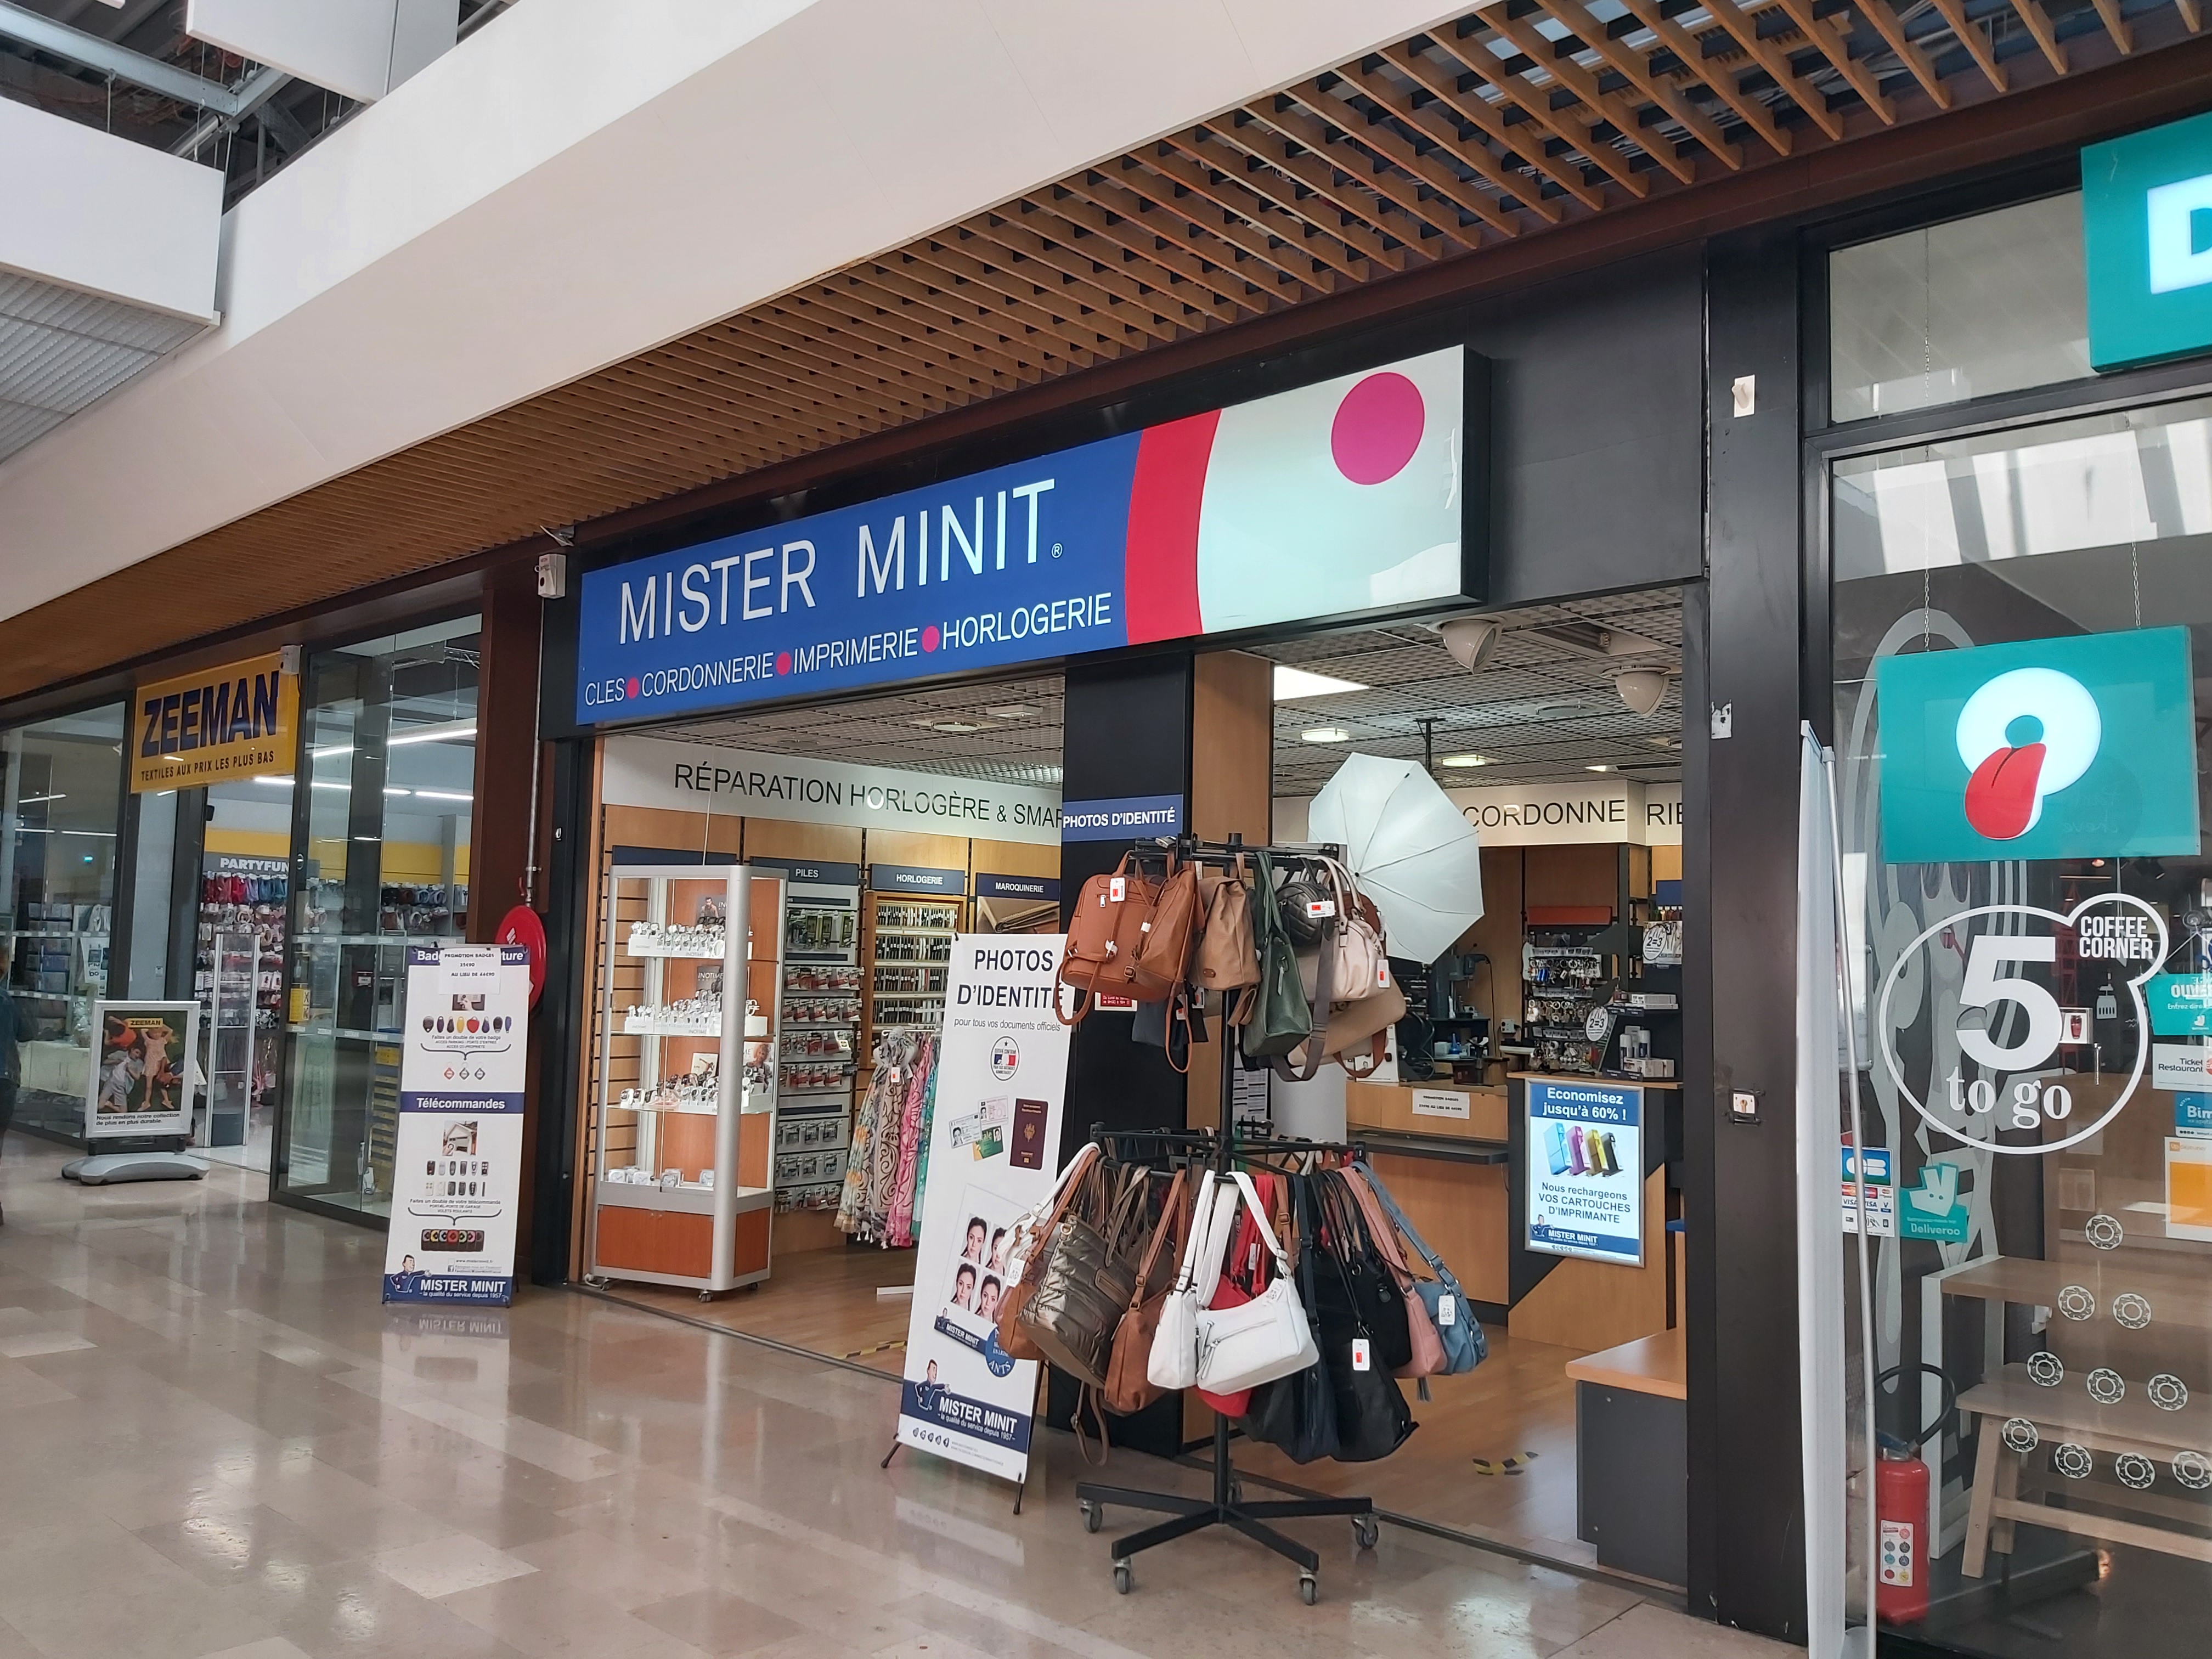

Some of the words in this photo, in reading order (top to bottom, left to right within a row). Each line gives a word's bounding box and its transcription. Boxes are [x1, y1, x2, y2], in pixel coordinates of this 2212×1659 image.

[619, 540, 816, 645] MISTER
[857, 478, 1055, 598] MINIT
[585, 678, 625, 706] CLES
[642, 652, 774, 697] CORDONNERIE
[793, 627, 918, 674] IMPRIMERIE
[943, 592, 1111, 651] HORLOGERIE
[141, 670, 279, 758] ZEEMAN
[141, 765, 173, 781] TEXTILES
[177, 763, 191, 776] AUX
[194, 760, 212, 774] PRIX
[216, 757, 229, 771] LES
[233, 753, 253, 767] PLUS
[257, 750, 274, 764] BAS
[674, 760, 841, 806] RÉPARATION
[850, 783, 990, 821] HORLOGÈRE
[996, 805, 1008, 822] &
[1063, 814, 1109, 828] PHOTOS
[1111, 806, 1175, 826] D’IDENTITÉ
[221, 857, 289, 872] PARTYFUN
[795, 868, 819, 878] PILES
[896, 873, 944, 885] HORLOGERIE
[995, 882, 1044, 893] MAROQUINERIE
[2081, 916, 2148, 938] COFFEE
[1646, 936, 1663, 947] 2=3
[2079, 937, 2153, 960] CORNER
[974, 950, 1053, 972] PHOTOS
[1955, 935, 2063, 1071] 5
[954, 1019, 971, 1027] pour
[973, 1018, 986, 1027] tous
[1000, 1019, 1035, 1030] documents
[1036, 1022, 1060, 1031] officiels
[1589, 1018, 1605, 1028] 2=3
[2158, 1063, 2203, 1073] Restaurant
[2179, 1058, 2203, 1066] Ticket
[416, 1097, 505, 1109] Télécommandes
[1547, 1087, 1624, 1104] Economisez
[1946, 1066, 1996, 1113] to
[2012, 1079, 2072, 1129] go
[1543, 1103, 1589, 1118] jusqu’à
[1592, 1107, 1618, 1120] 60%
[1622, 1109, 1627, 1120] !
[1542, 1182, 1565, 1193] Nous
[1568, 1187, 1628, 1200] rechargeons
[1538, 1193, 1559, 1203] VOS
[1561, 1197, 1630, 1213] CARTOUCHES
[1549, 1206, 1620, 1223] D'IMPRIMANTE
[1548, 1229, 1576, 1240] MISTER
[1577, 1233, 1598, 1243] MINIT
[1911, 1223, 1960, 1235] Deliveroo
[420, 1279, 468, 1291] MISTER
[471, 1280, 506, 1293] MINIT
[946, 1323, 965, 1339] MISTER
[966, 1333, 979, 1346] MINIT
[989, 1361, 1011, 1374] ANTS
[939, 1396, 982, 1424] MISTER
[984, 1410, 1017, 1434] MINIT
[946, 1415, 960, 1425] qualité
[967, 1422, 983, 1432] service
[984, 1426, 1000, 1438] depuis
